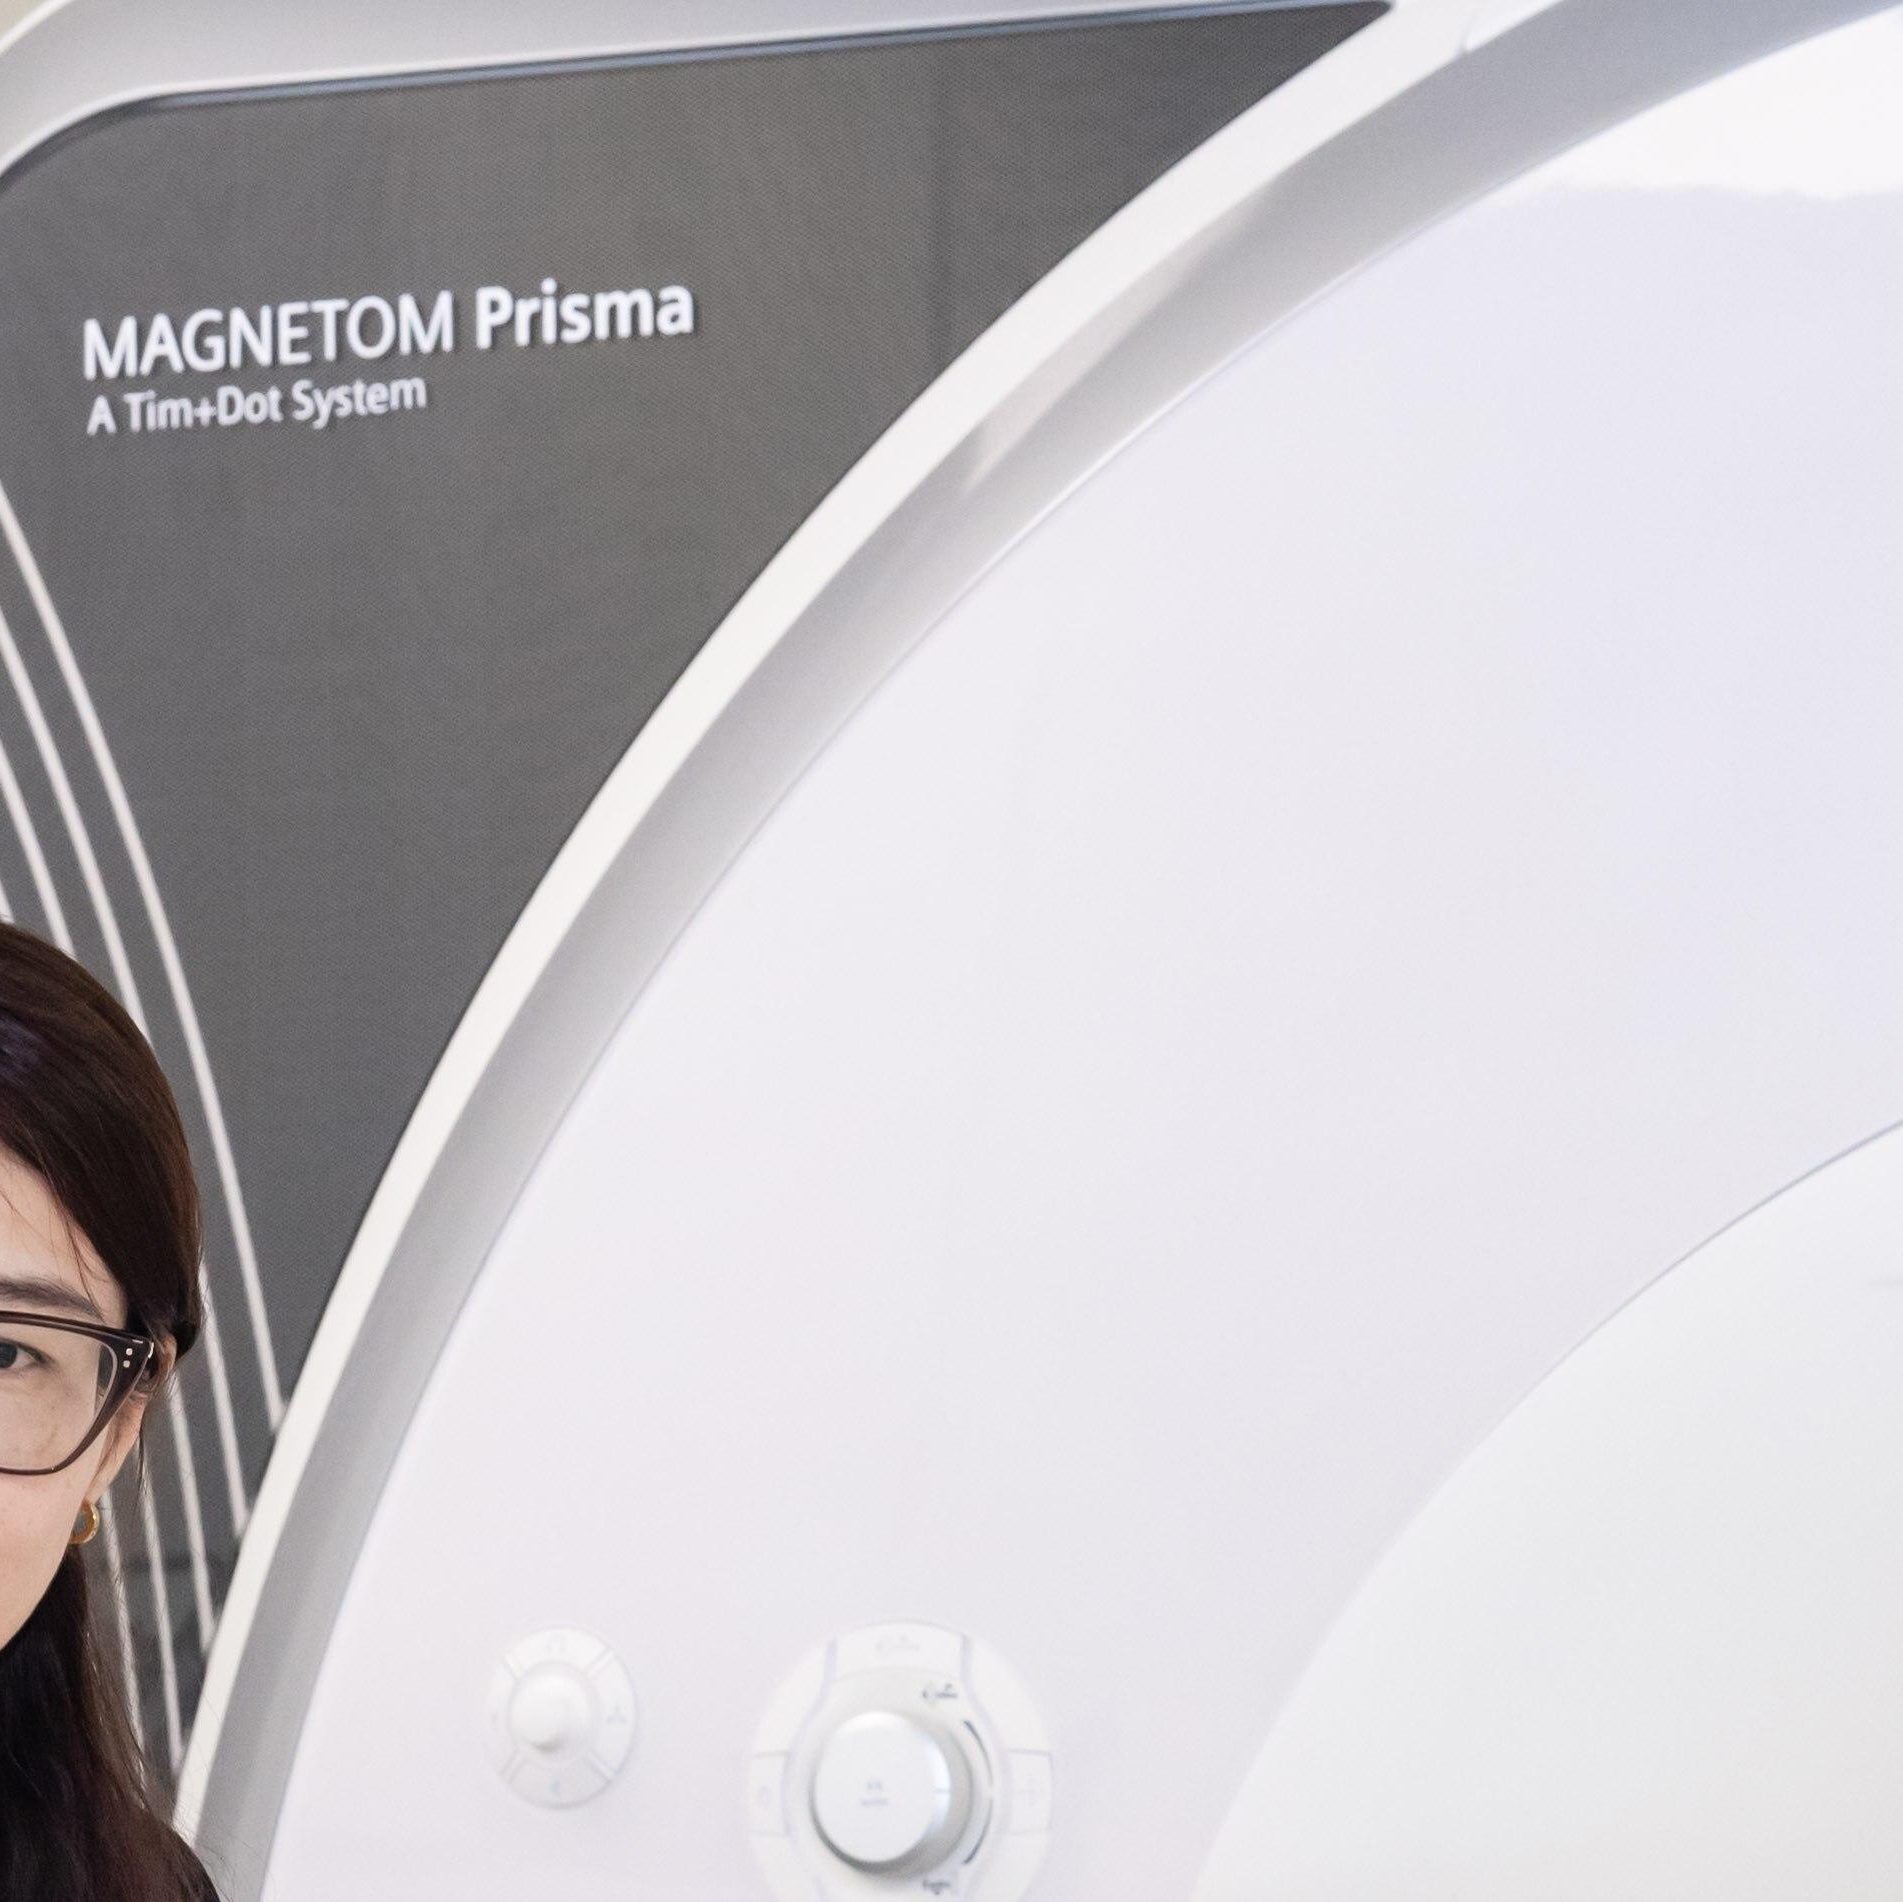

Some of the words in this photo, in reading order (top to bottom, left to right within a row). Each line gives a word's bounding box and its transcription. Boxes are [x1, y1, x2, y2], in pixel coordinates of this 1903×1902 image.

[83, 290, 454, 381] MAGNETOM
[476, 278, 695, 350] Prisma
[86, 395, 116, 436] A
[124, 384, 285, 434] Tim+Dot
[292, 376, 428, 430] System
